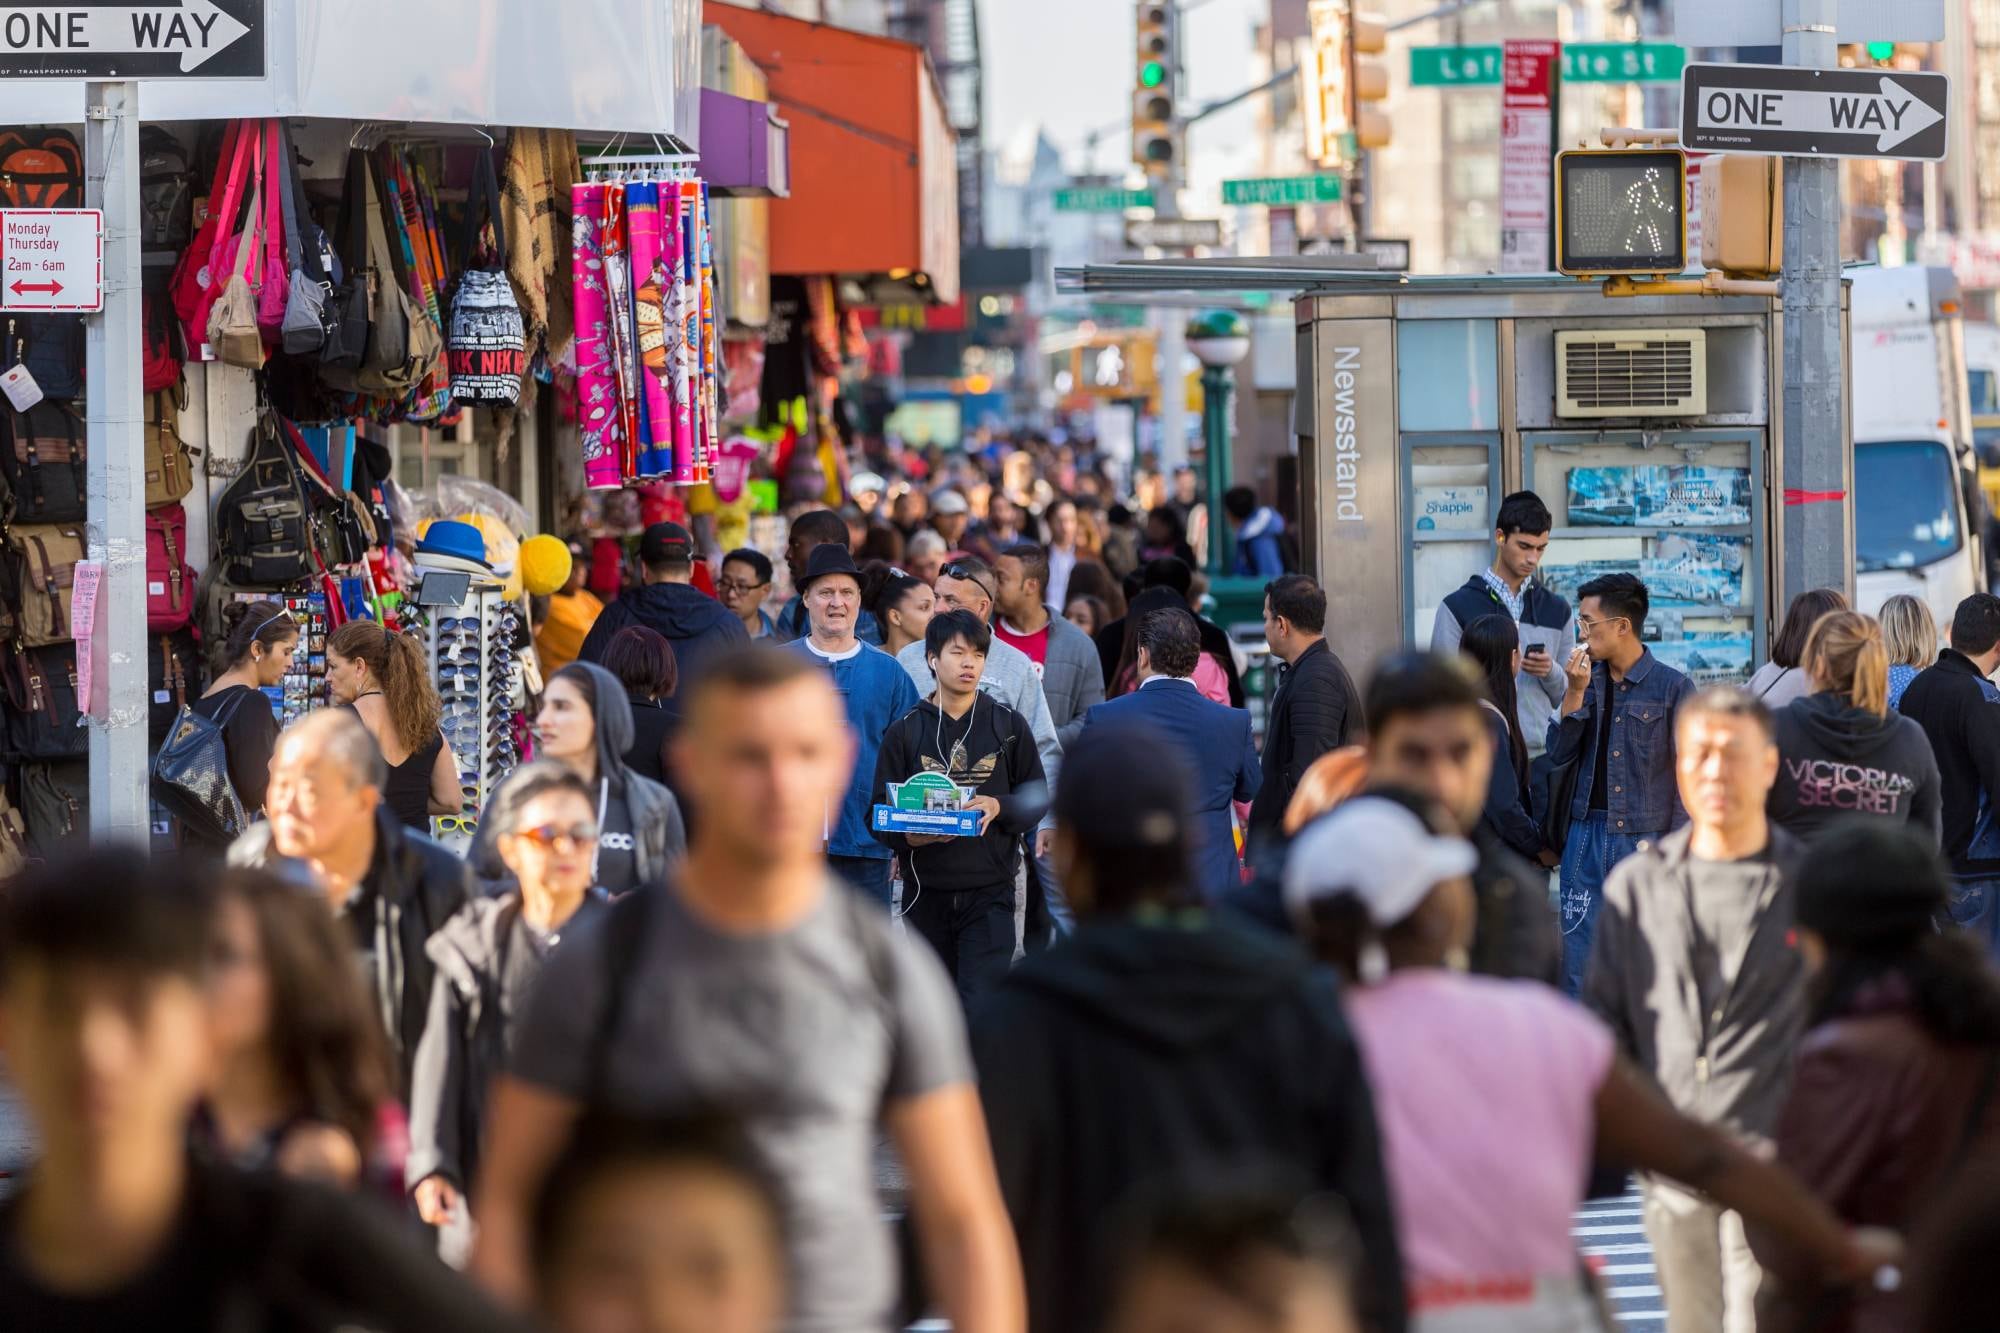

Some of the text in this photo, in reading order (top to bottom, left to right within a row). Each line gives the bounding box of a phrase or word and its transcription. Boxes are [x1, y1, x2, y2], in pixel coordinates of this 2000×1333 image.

[5, 13, 219, 48] ONE WAY
[1440, 51, 1610, 79] Laftte
[1622, 50, 1656, 76] St
[1707, 91, 1912, 131] ONE WAY
[1716, 135, 1752, 143] TRANSPORTATION
[8, 223, 51, 237] Monday
[8, 237, 59, 252] Thursday
[8, 256, 31, 271] 2am
[42, 259, 65, 271] 6am
[480, 336, 497, 345] NEW
[1334, 346, 1363, 521] Newsstand
[1426, 501, 1473, 516] Snapple
[295, 599, 308, 609] NY
[311, 622, 322, 632] NY
[1797, 779, 1899, 815] SECRET
[878, 809, 888, 817] 60
[1567, 888, 1591, 907] brief
